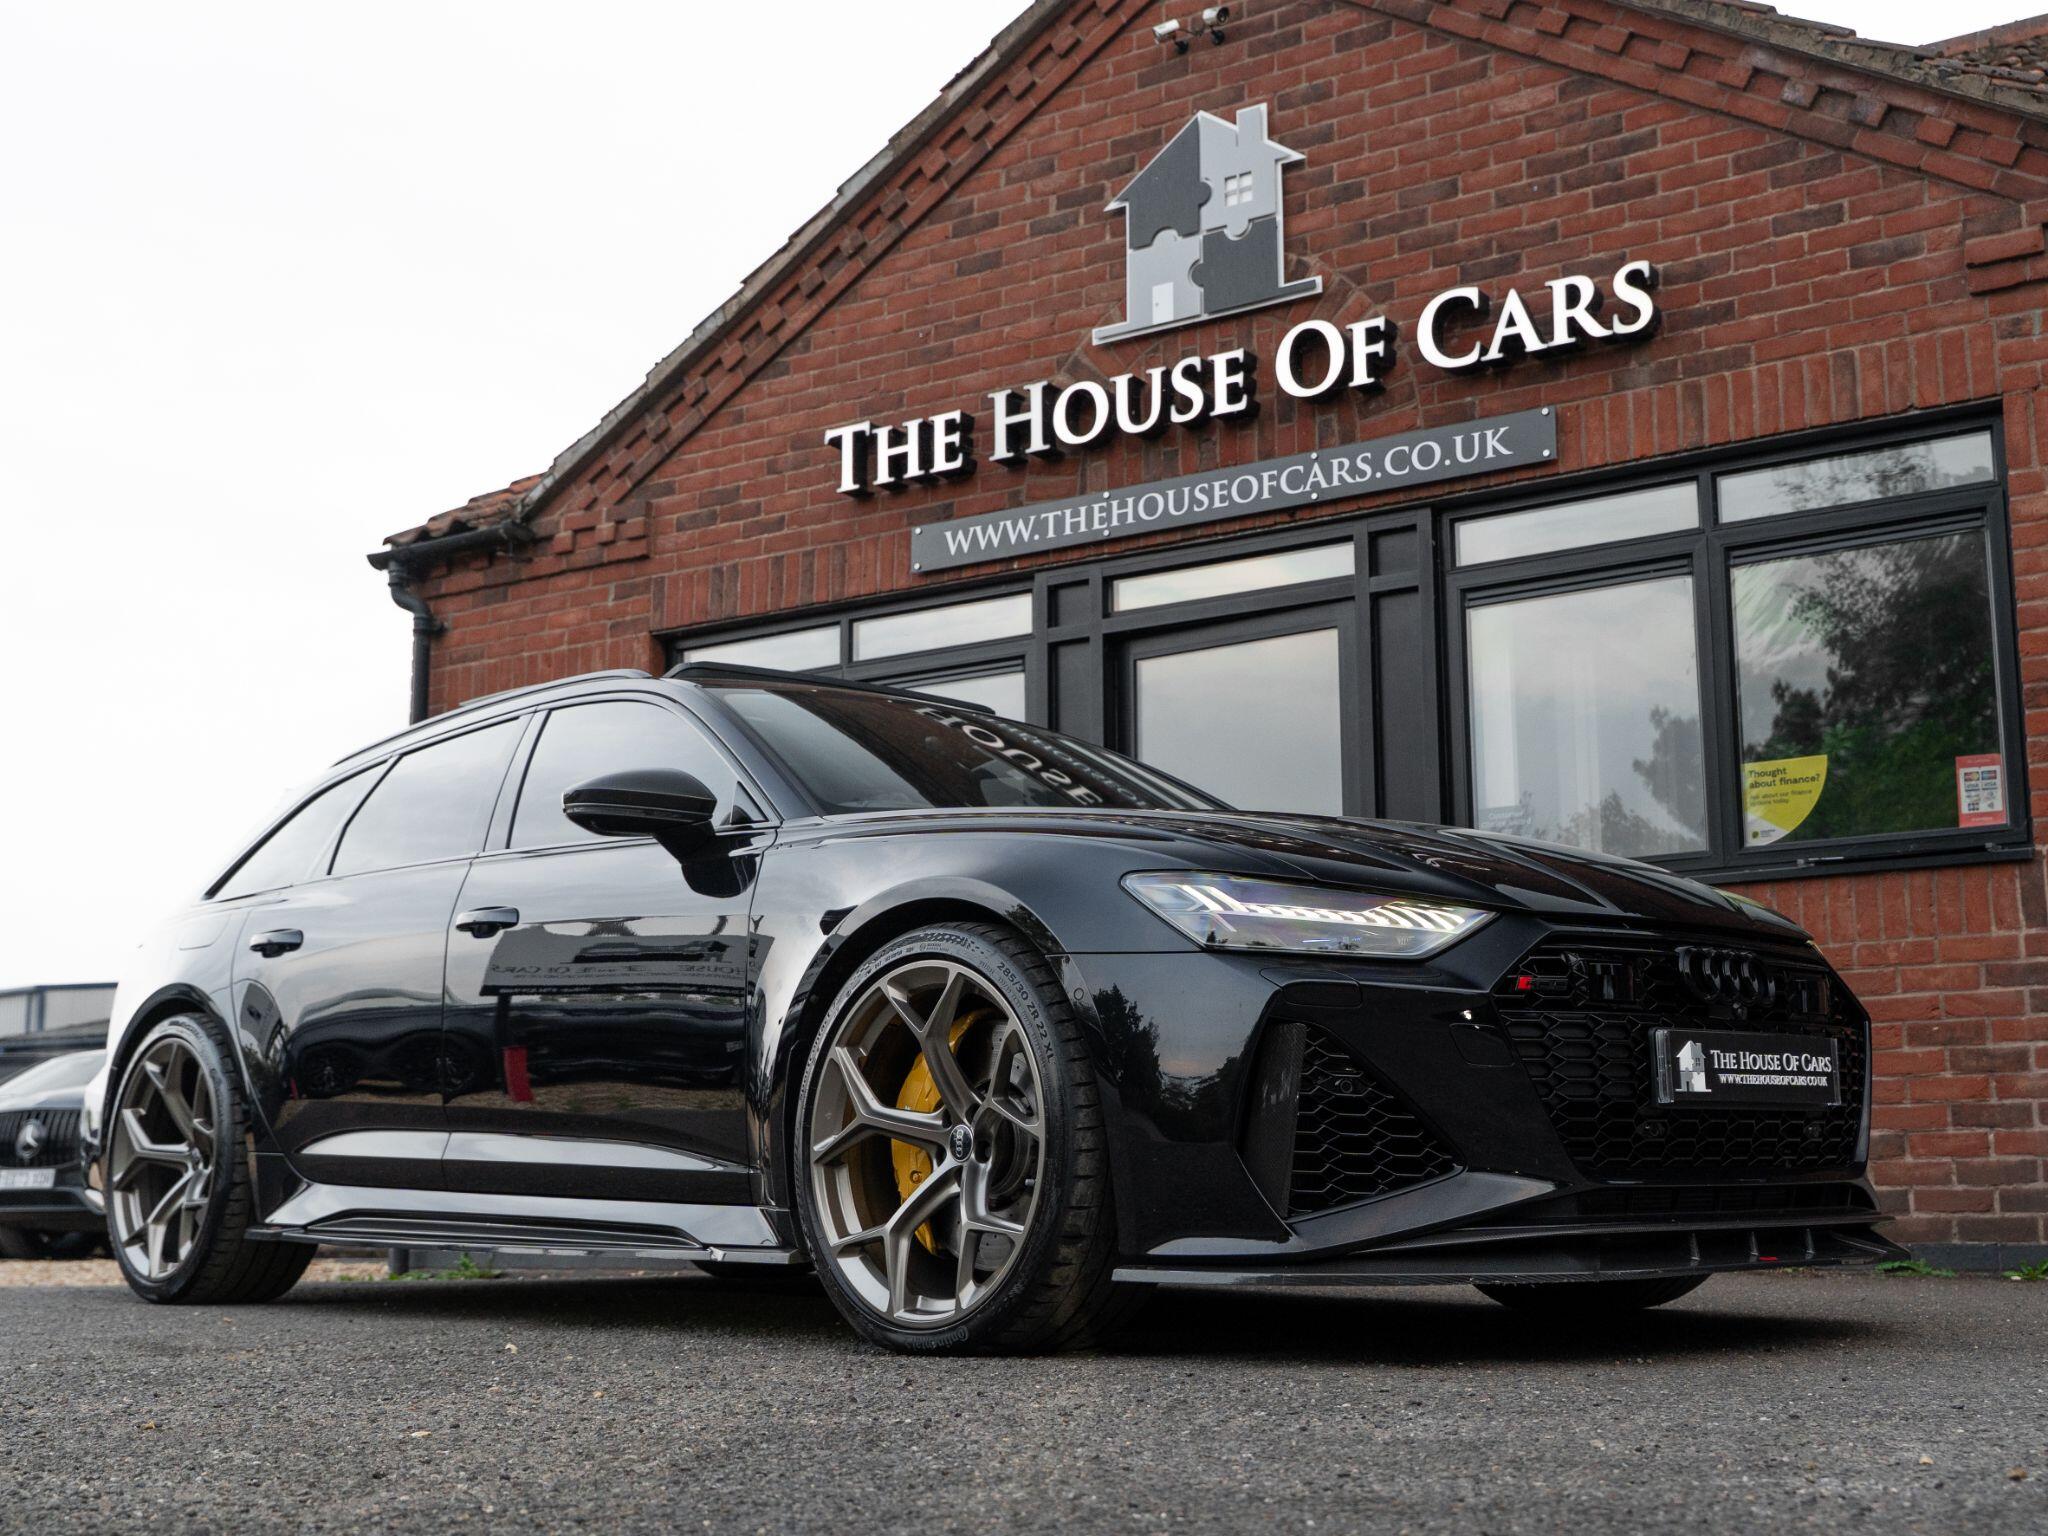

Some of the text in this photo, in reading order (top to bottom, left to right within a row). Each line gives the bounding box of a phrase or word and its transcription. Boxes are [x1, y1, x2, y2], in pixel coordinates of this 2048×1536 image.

[824, 260, 1656, 495] THE HOUSE OF CARS
[944, 426, 1513, 556] WWW.THEHOUSEOFCARS.CO.UK
[1749, 767, 1787, 779] Thought
[1749, 773, 1821, 789] about finance?
[996, 958, 1055, 1064] 285/30 ZR 22 XL
[1710, 1049, 1832, 1073] THE HOUSE OF CARS
